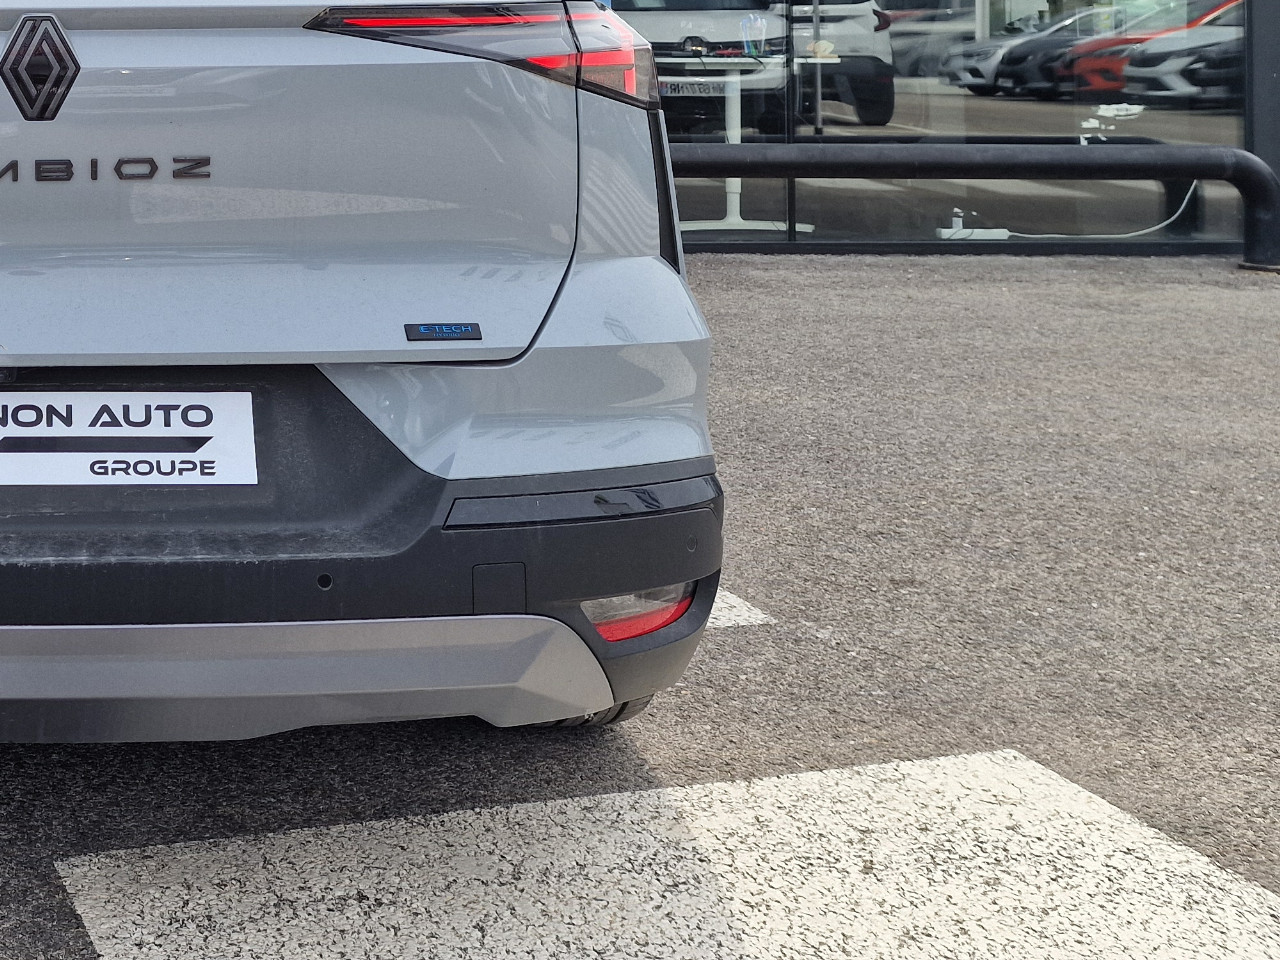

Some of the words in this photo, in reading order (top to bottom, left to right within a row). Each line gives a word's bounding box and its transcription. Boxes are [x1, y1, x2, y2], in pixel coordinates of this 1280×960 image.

[419, 325, 472, 334] E-TECH
[88, 403, 215, 428] AUTO
[89, 460, 216, 477] GROUPE
